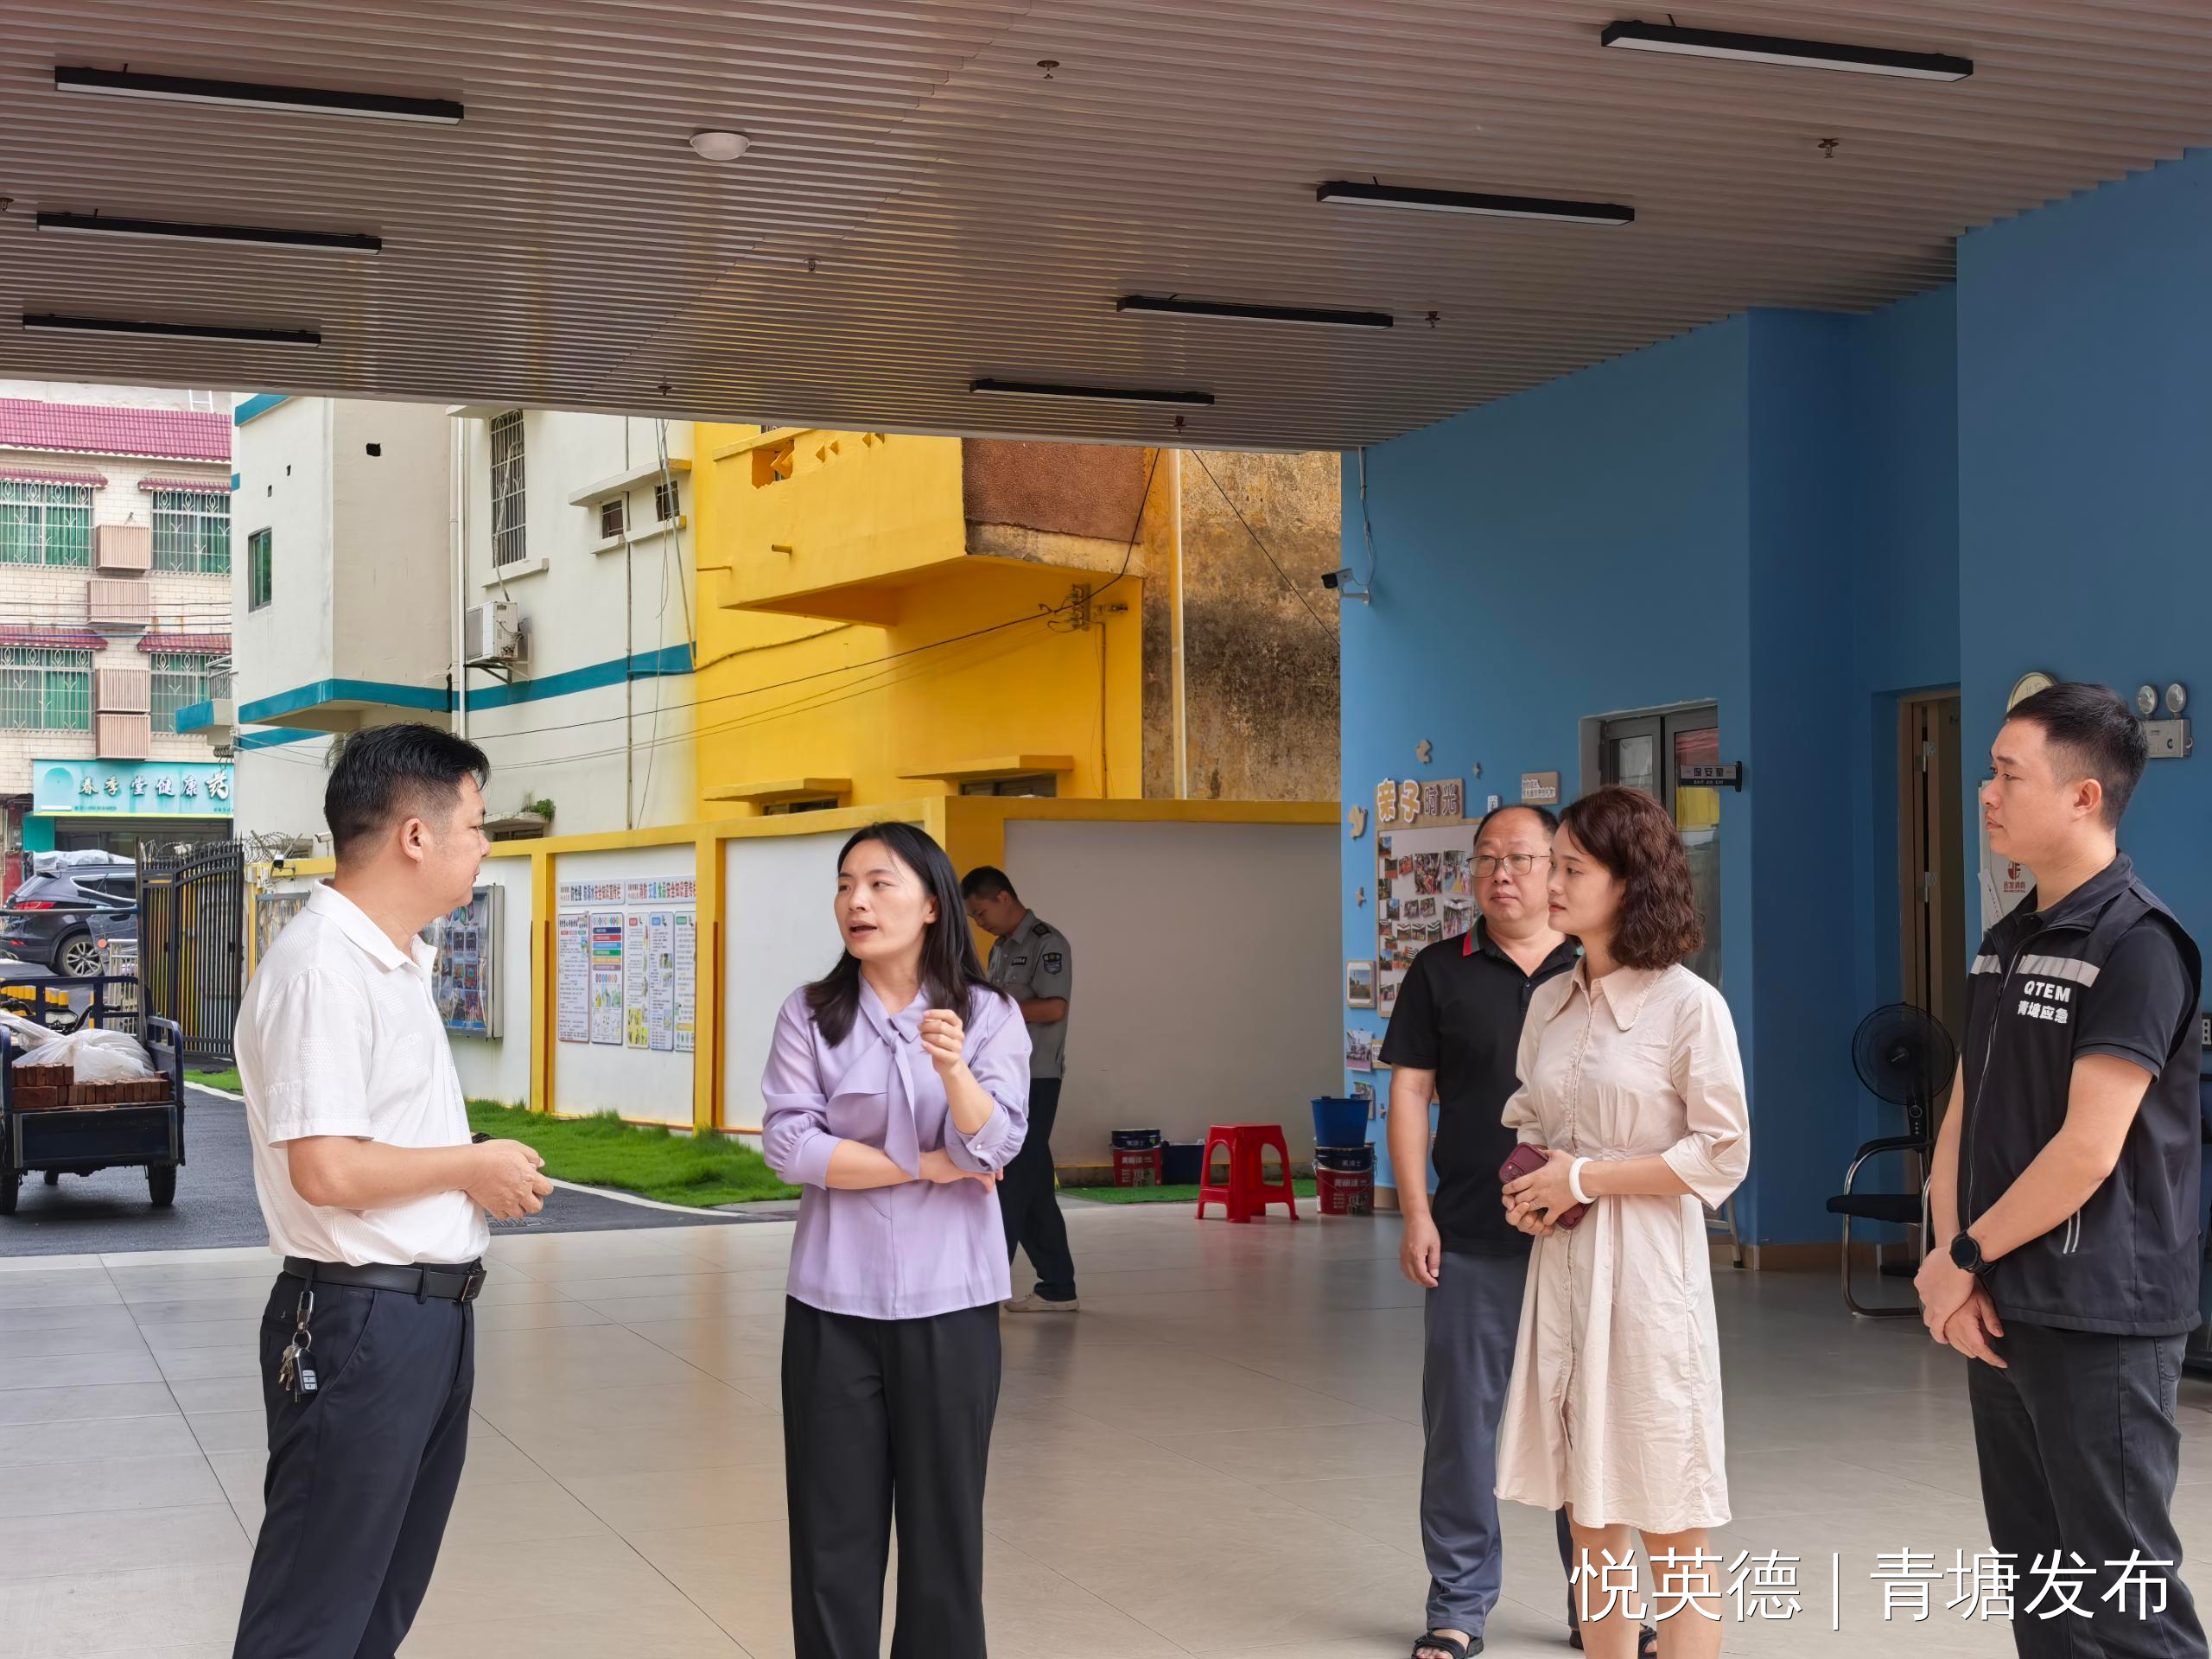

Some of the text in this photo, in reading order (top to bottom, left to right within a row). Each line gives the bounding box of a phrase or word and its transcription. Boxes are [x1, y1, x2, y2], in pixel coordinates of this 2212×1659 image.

[1376, 778, 1459, 823] 亲子时光
[2024, 980, 2071, 1003] QTEM
[2017, 1000, 2068, 1024] 青塘应急
